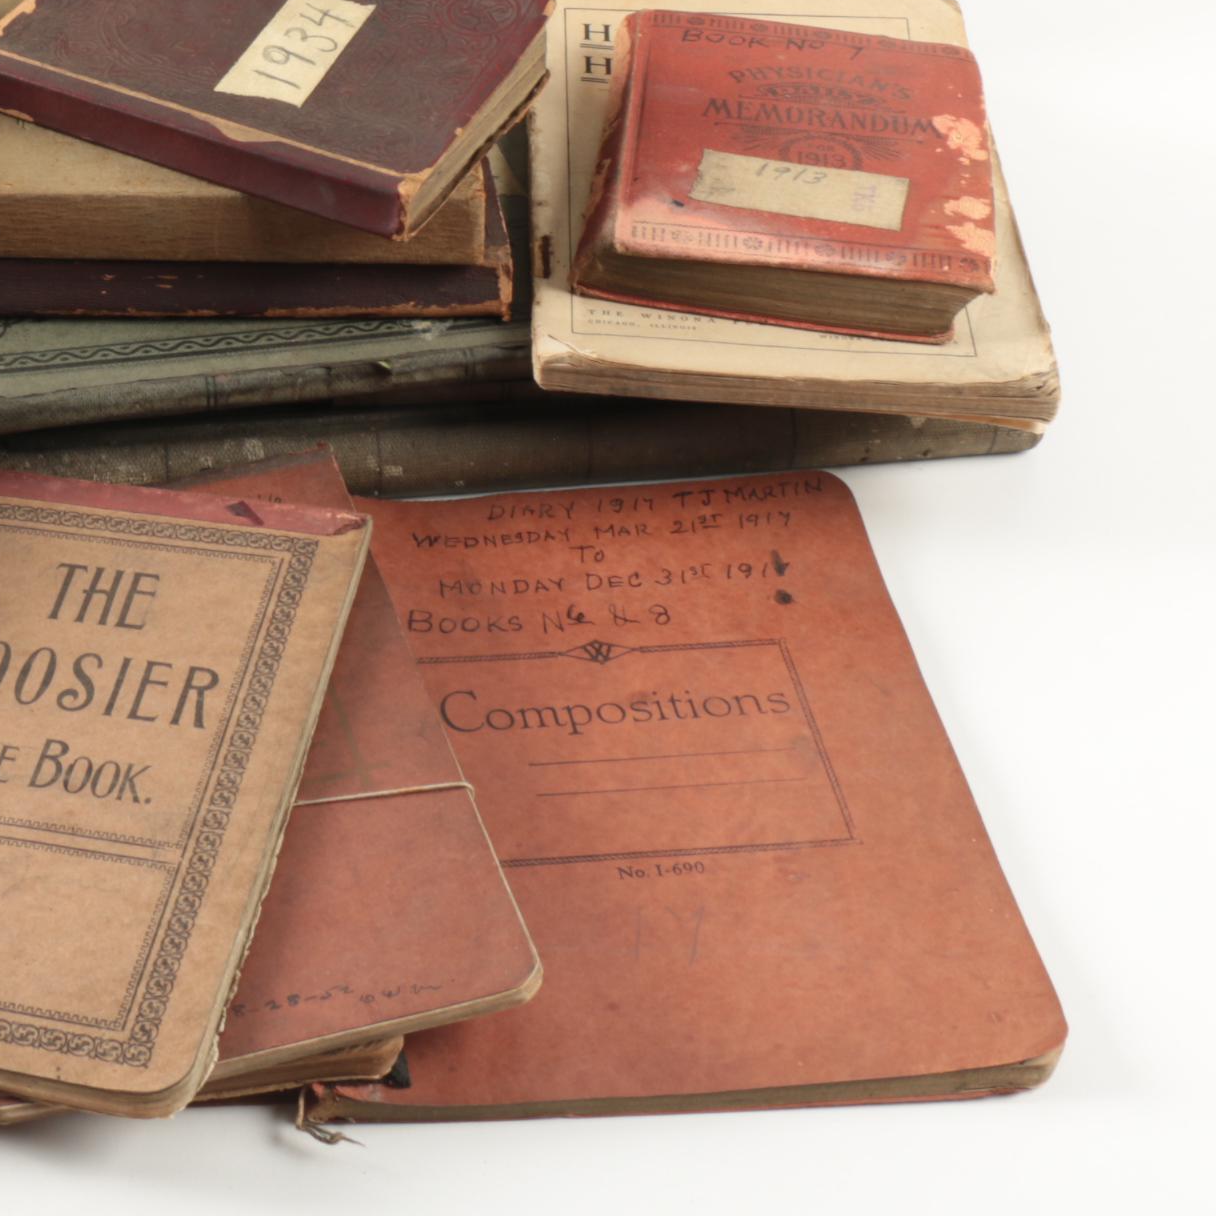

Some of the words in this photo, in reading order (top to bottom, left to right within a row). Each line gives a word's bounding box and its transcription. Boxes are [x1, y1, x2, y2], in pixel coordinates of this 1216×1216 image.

[254, 2, 355, 89] 1934
[682, 29, 769, 48] BOOK
[702, 98, 942, 139] MEMORANDUM
[756, 162, 827, 184] 1913
[487, 501, 575, 521] DIARY
[725, 477, 824, 503] MARTIN
[412, 528, 571, 548] WEDNESDAY
[593, 522, 650, 540] MAR
[47, 563, 160, 630] THE
[439, 576, 565, 599] MONDAY
[585, 571, 643, 591] DEC
[408, 609, 524, 634] BOOKS
[439, 688, 791, 735] Compositions
[28, 739, 152, 805] BOOK.
